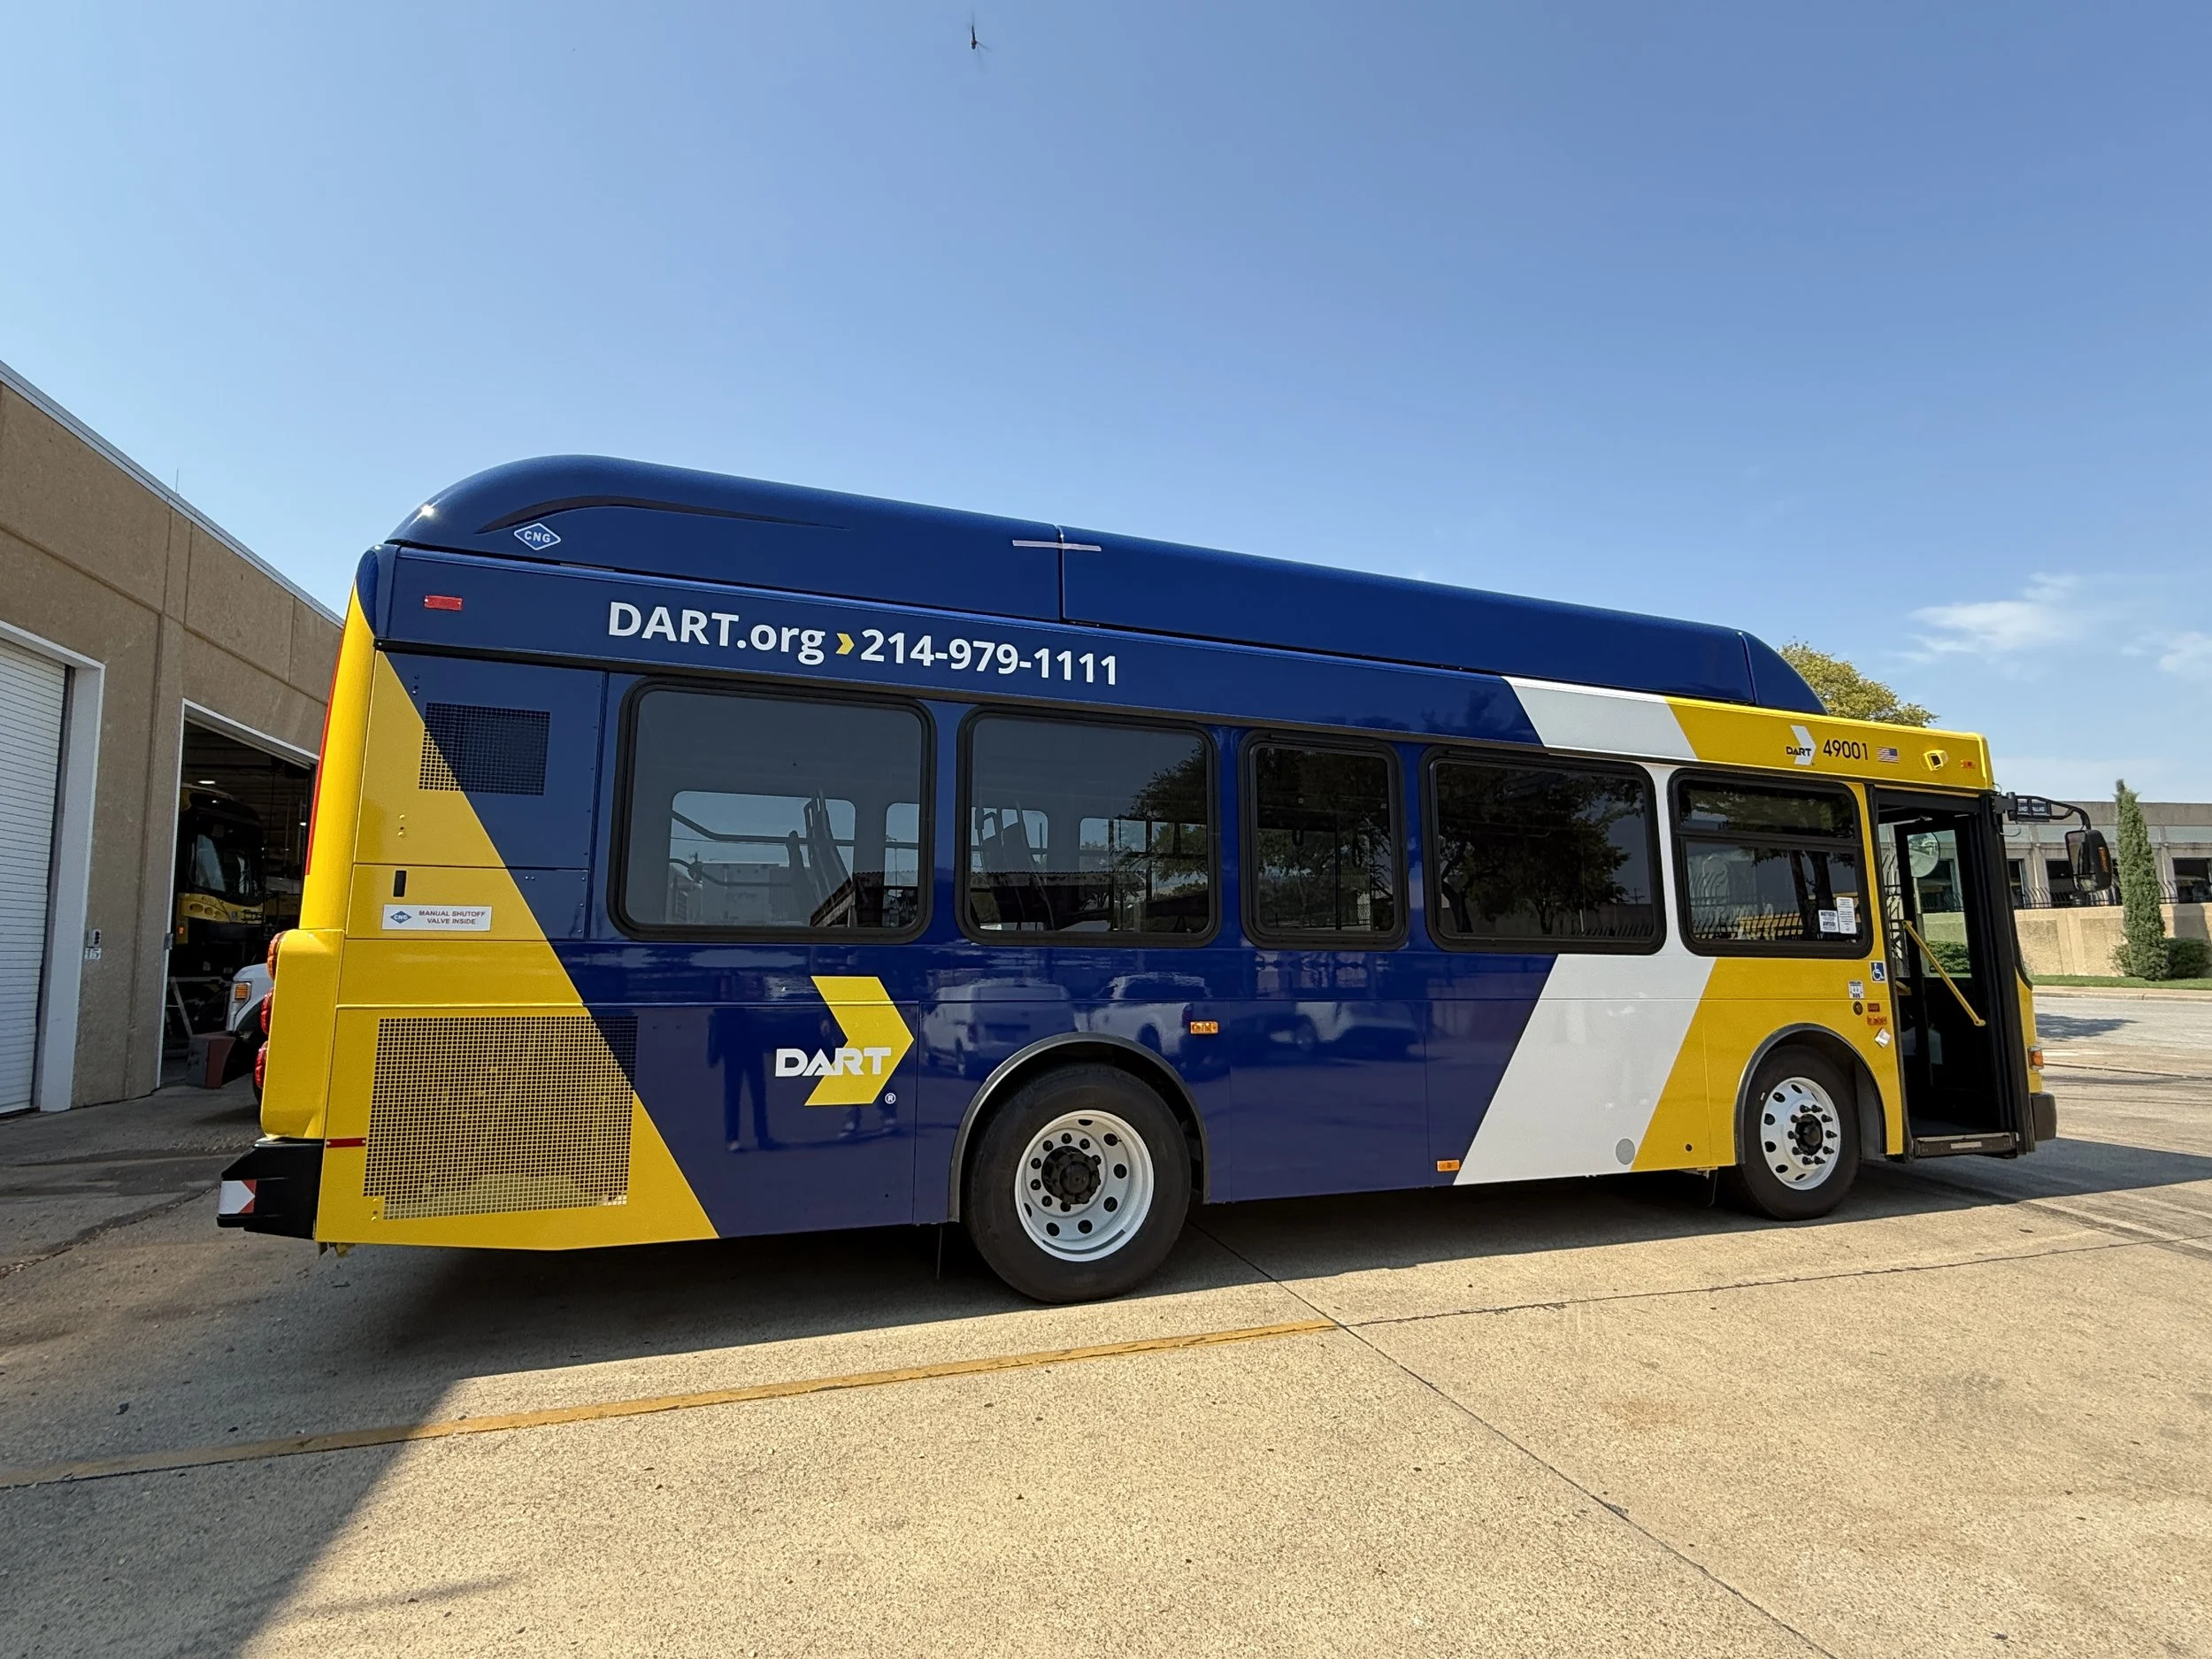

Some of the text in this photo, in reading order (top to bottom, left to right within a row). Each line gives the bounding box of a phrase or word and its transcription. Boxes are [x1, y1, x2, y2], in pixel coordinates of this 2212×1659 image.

[524, 530, 551, 543] CNG
[607, 601, 1118, 685] DART.org 214-979-1111
[1786, 746, 1812, 757] DART
[1823, 738, 1869, 761] 49001
[87, 949, 100, 959] 15
[775, 1047, 892, 1077] DART
